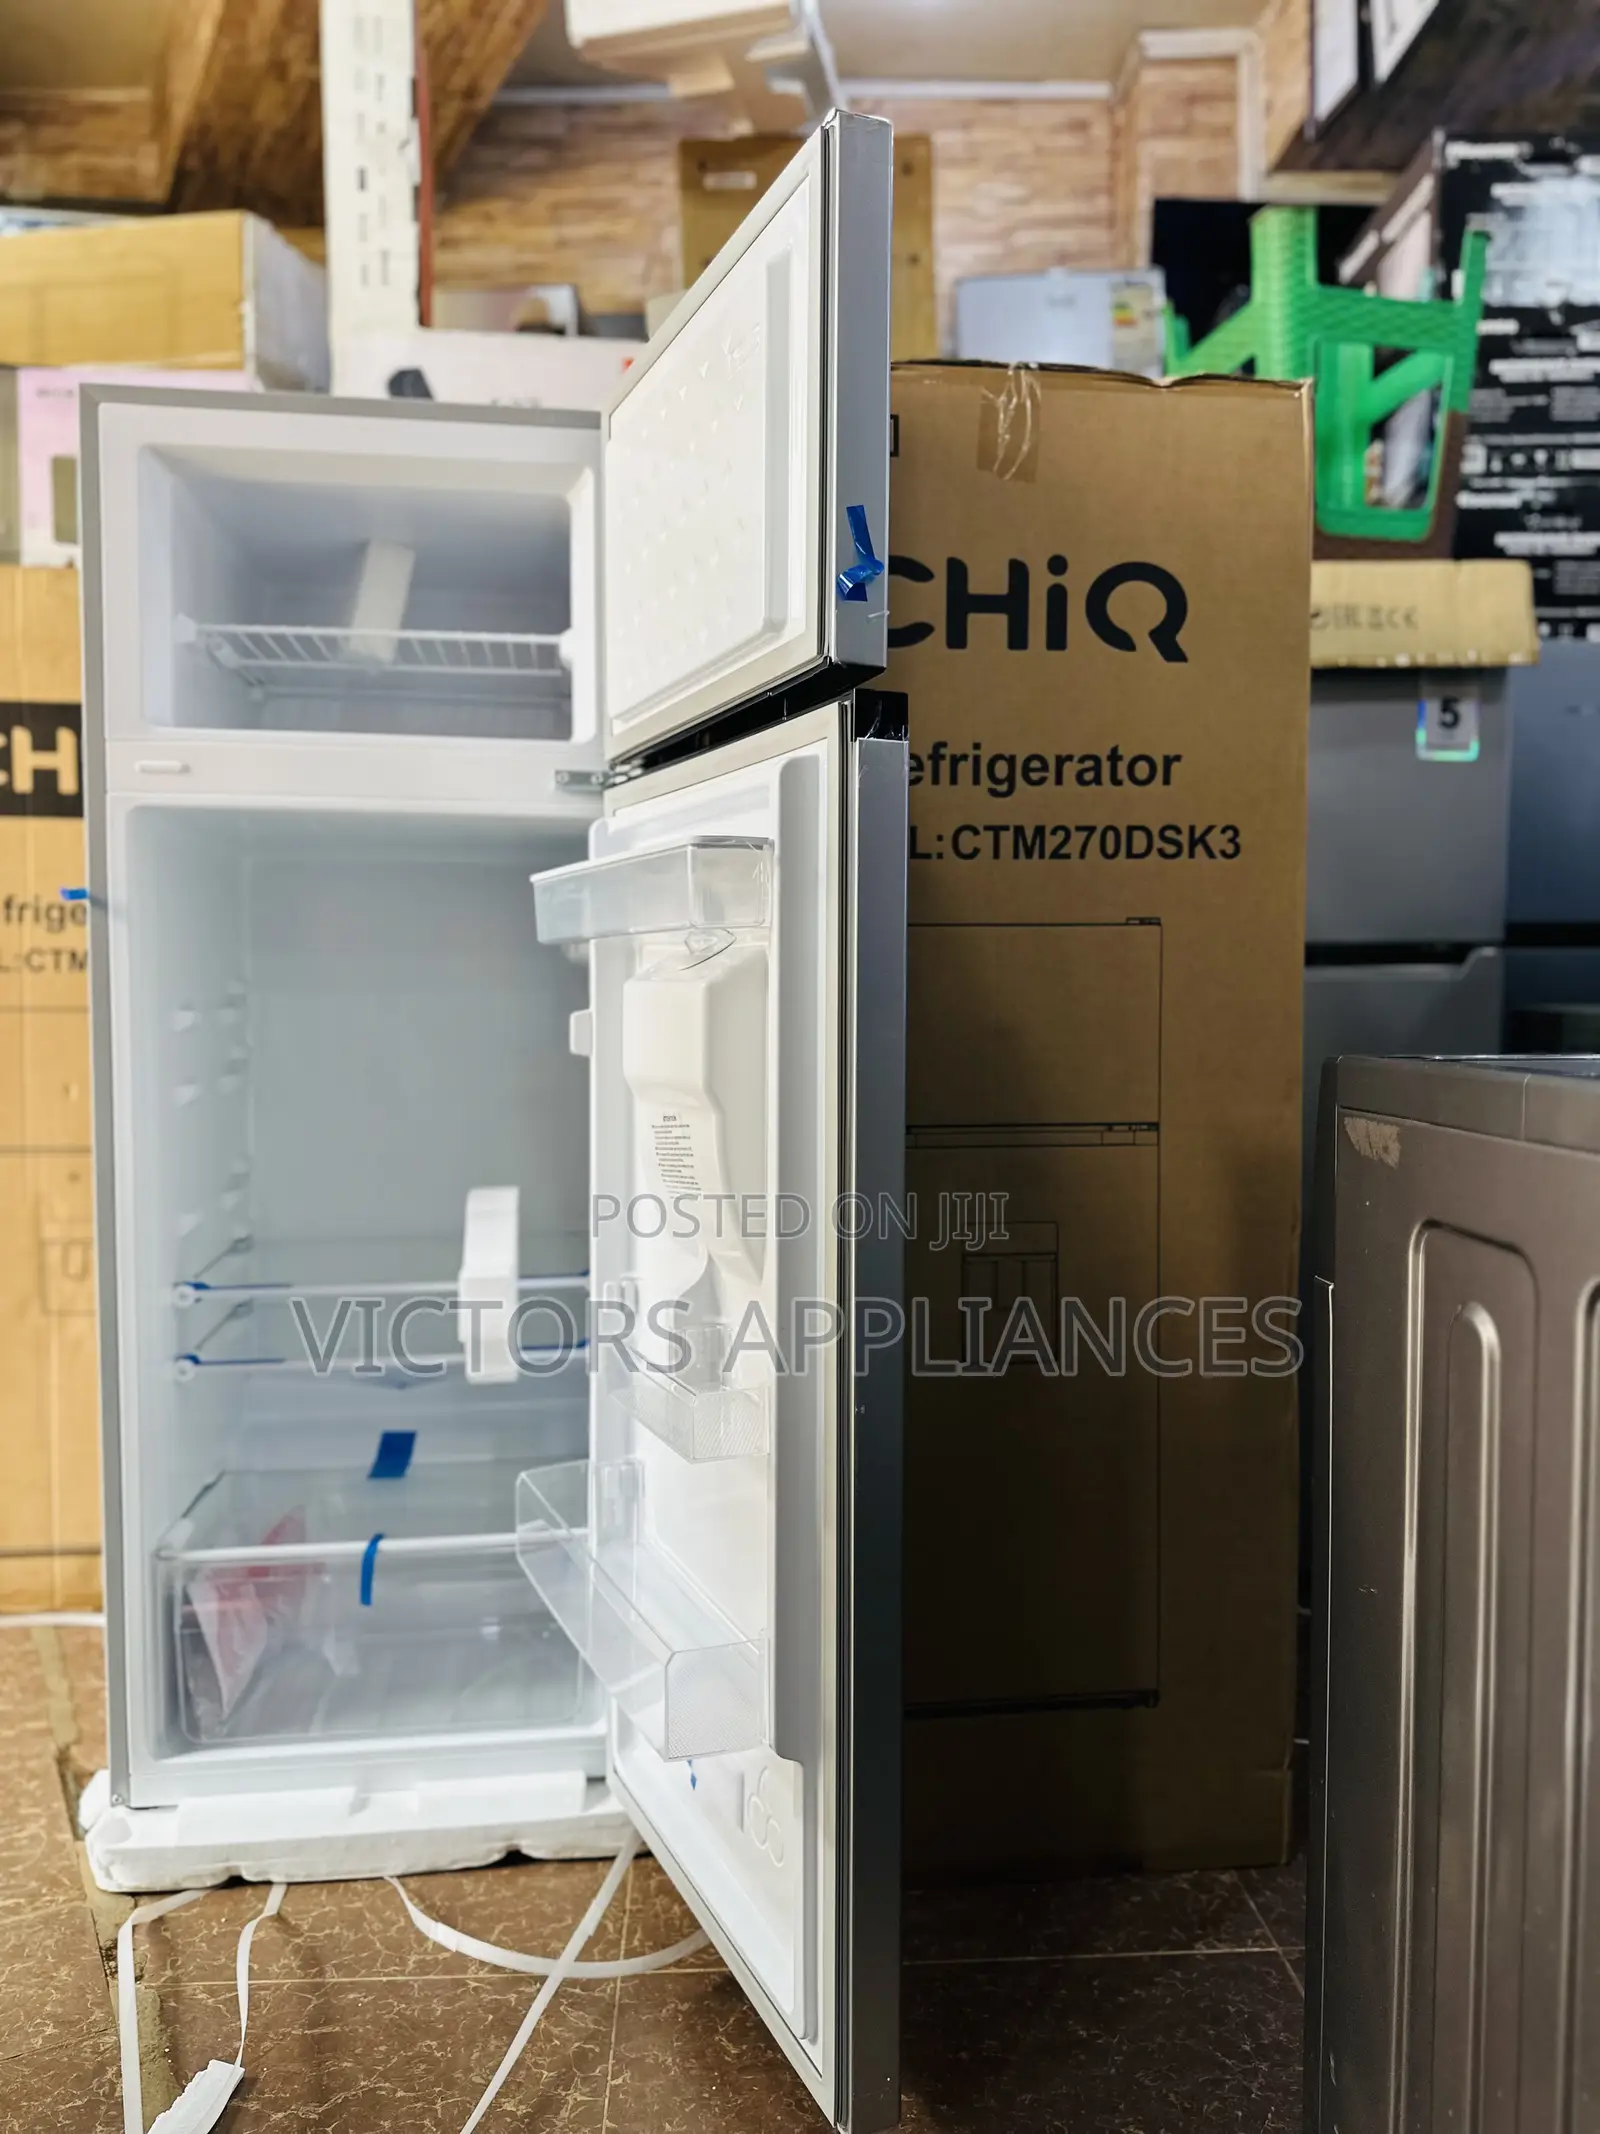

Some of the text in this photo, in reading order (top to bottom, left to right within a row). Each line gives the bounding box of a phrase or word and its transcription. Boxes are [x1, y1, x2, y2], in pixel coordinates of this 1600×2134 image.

[1438, 694, 1461, 730] 5
[0, 725, 79, 795] H
[909, 824, 1241, 861] L:CTM270DSK3
